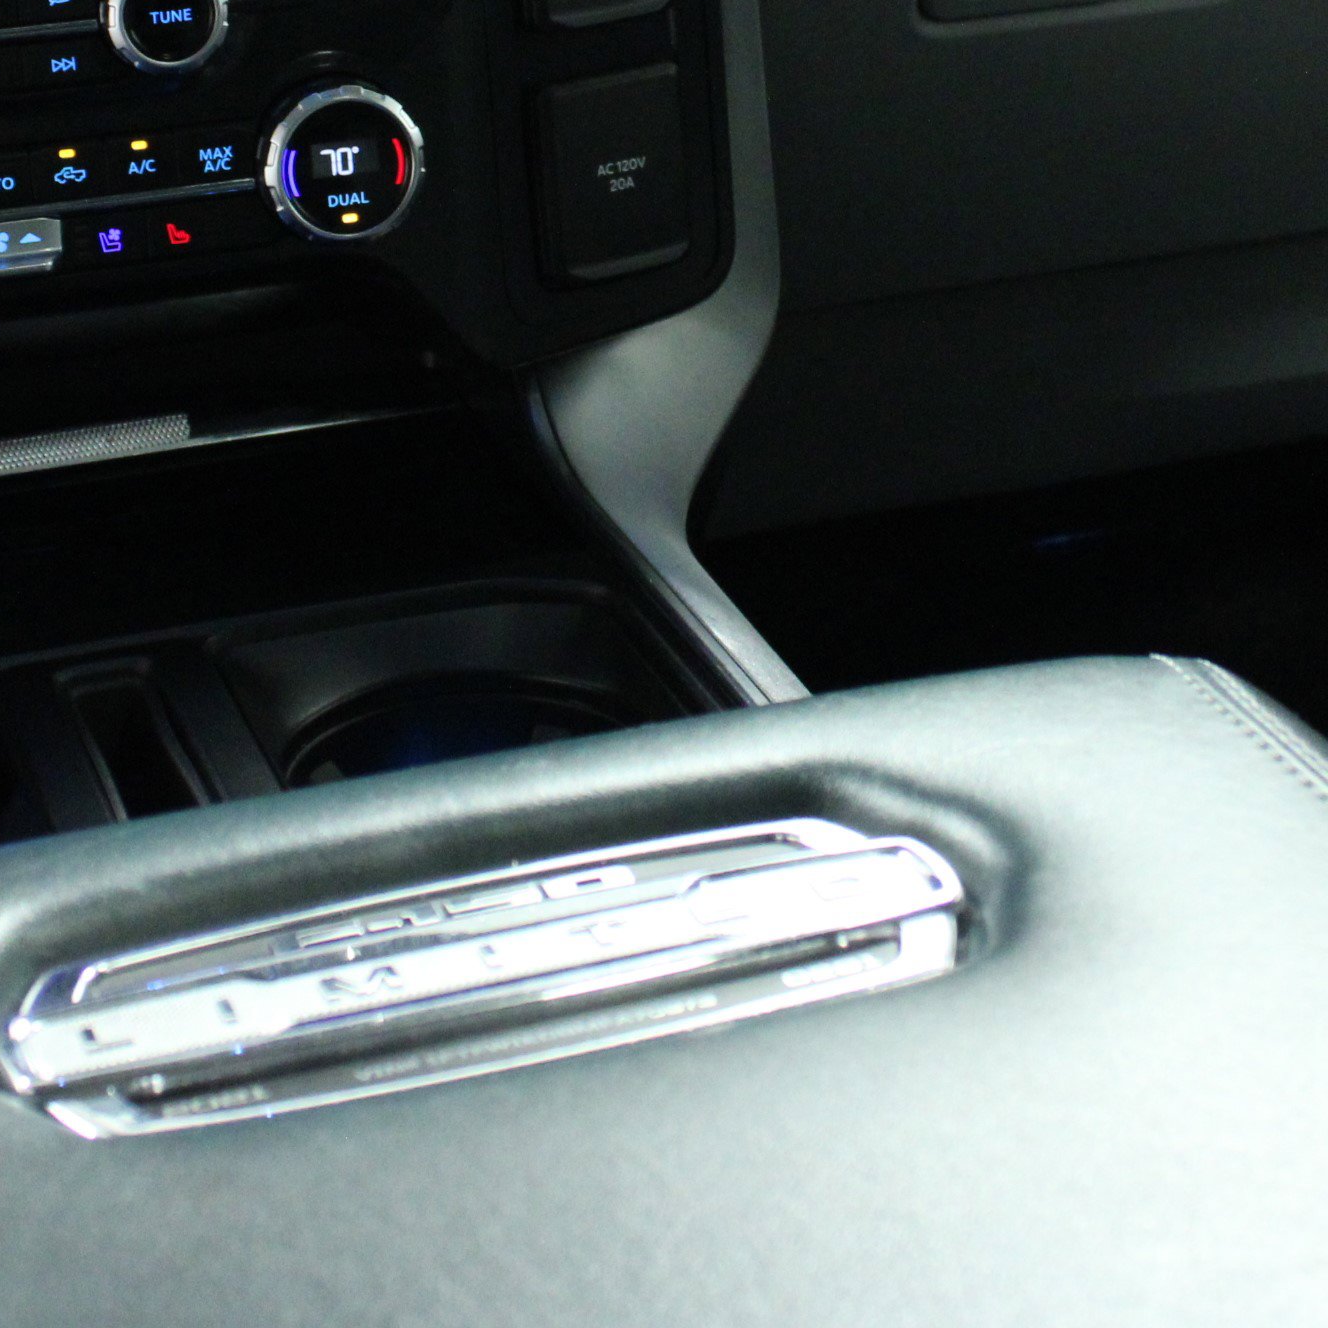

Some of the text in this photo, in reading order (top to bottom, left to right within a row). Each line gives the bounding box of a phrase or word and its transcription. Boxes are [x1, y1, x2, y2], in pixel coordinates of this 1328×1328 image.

[149, 7, 193, 25] TUNE
[198, 145, 233, 162] MAX
[128, 158, 157, 175] A/C
[203, 157, 232, 173] A/C
[597, 156, 647, 178] AC 120V
[609, 176, 635, 193] 20A
[327, 190, 370, 209] DUAL
